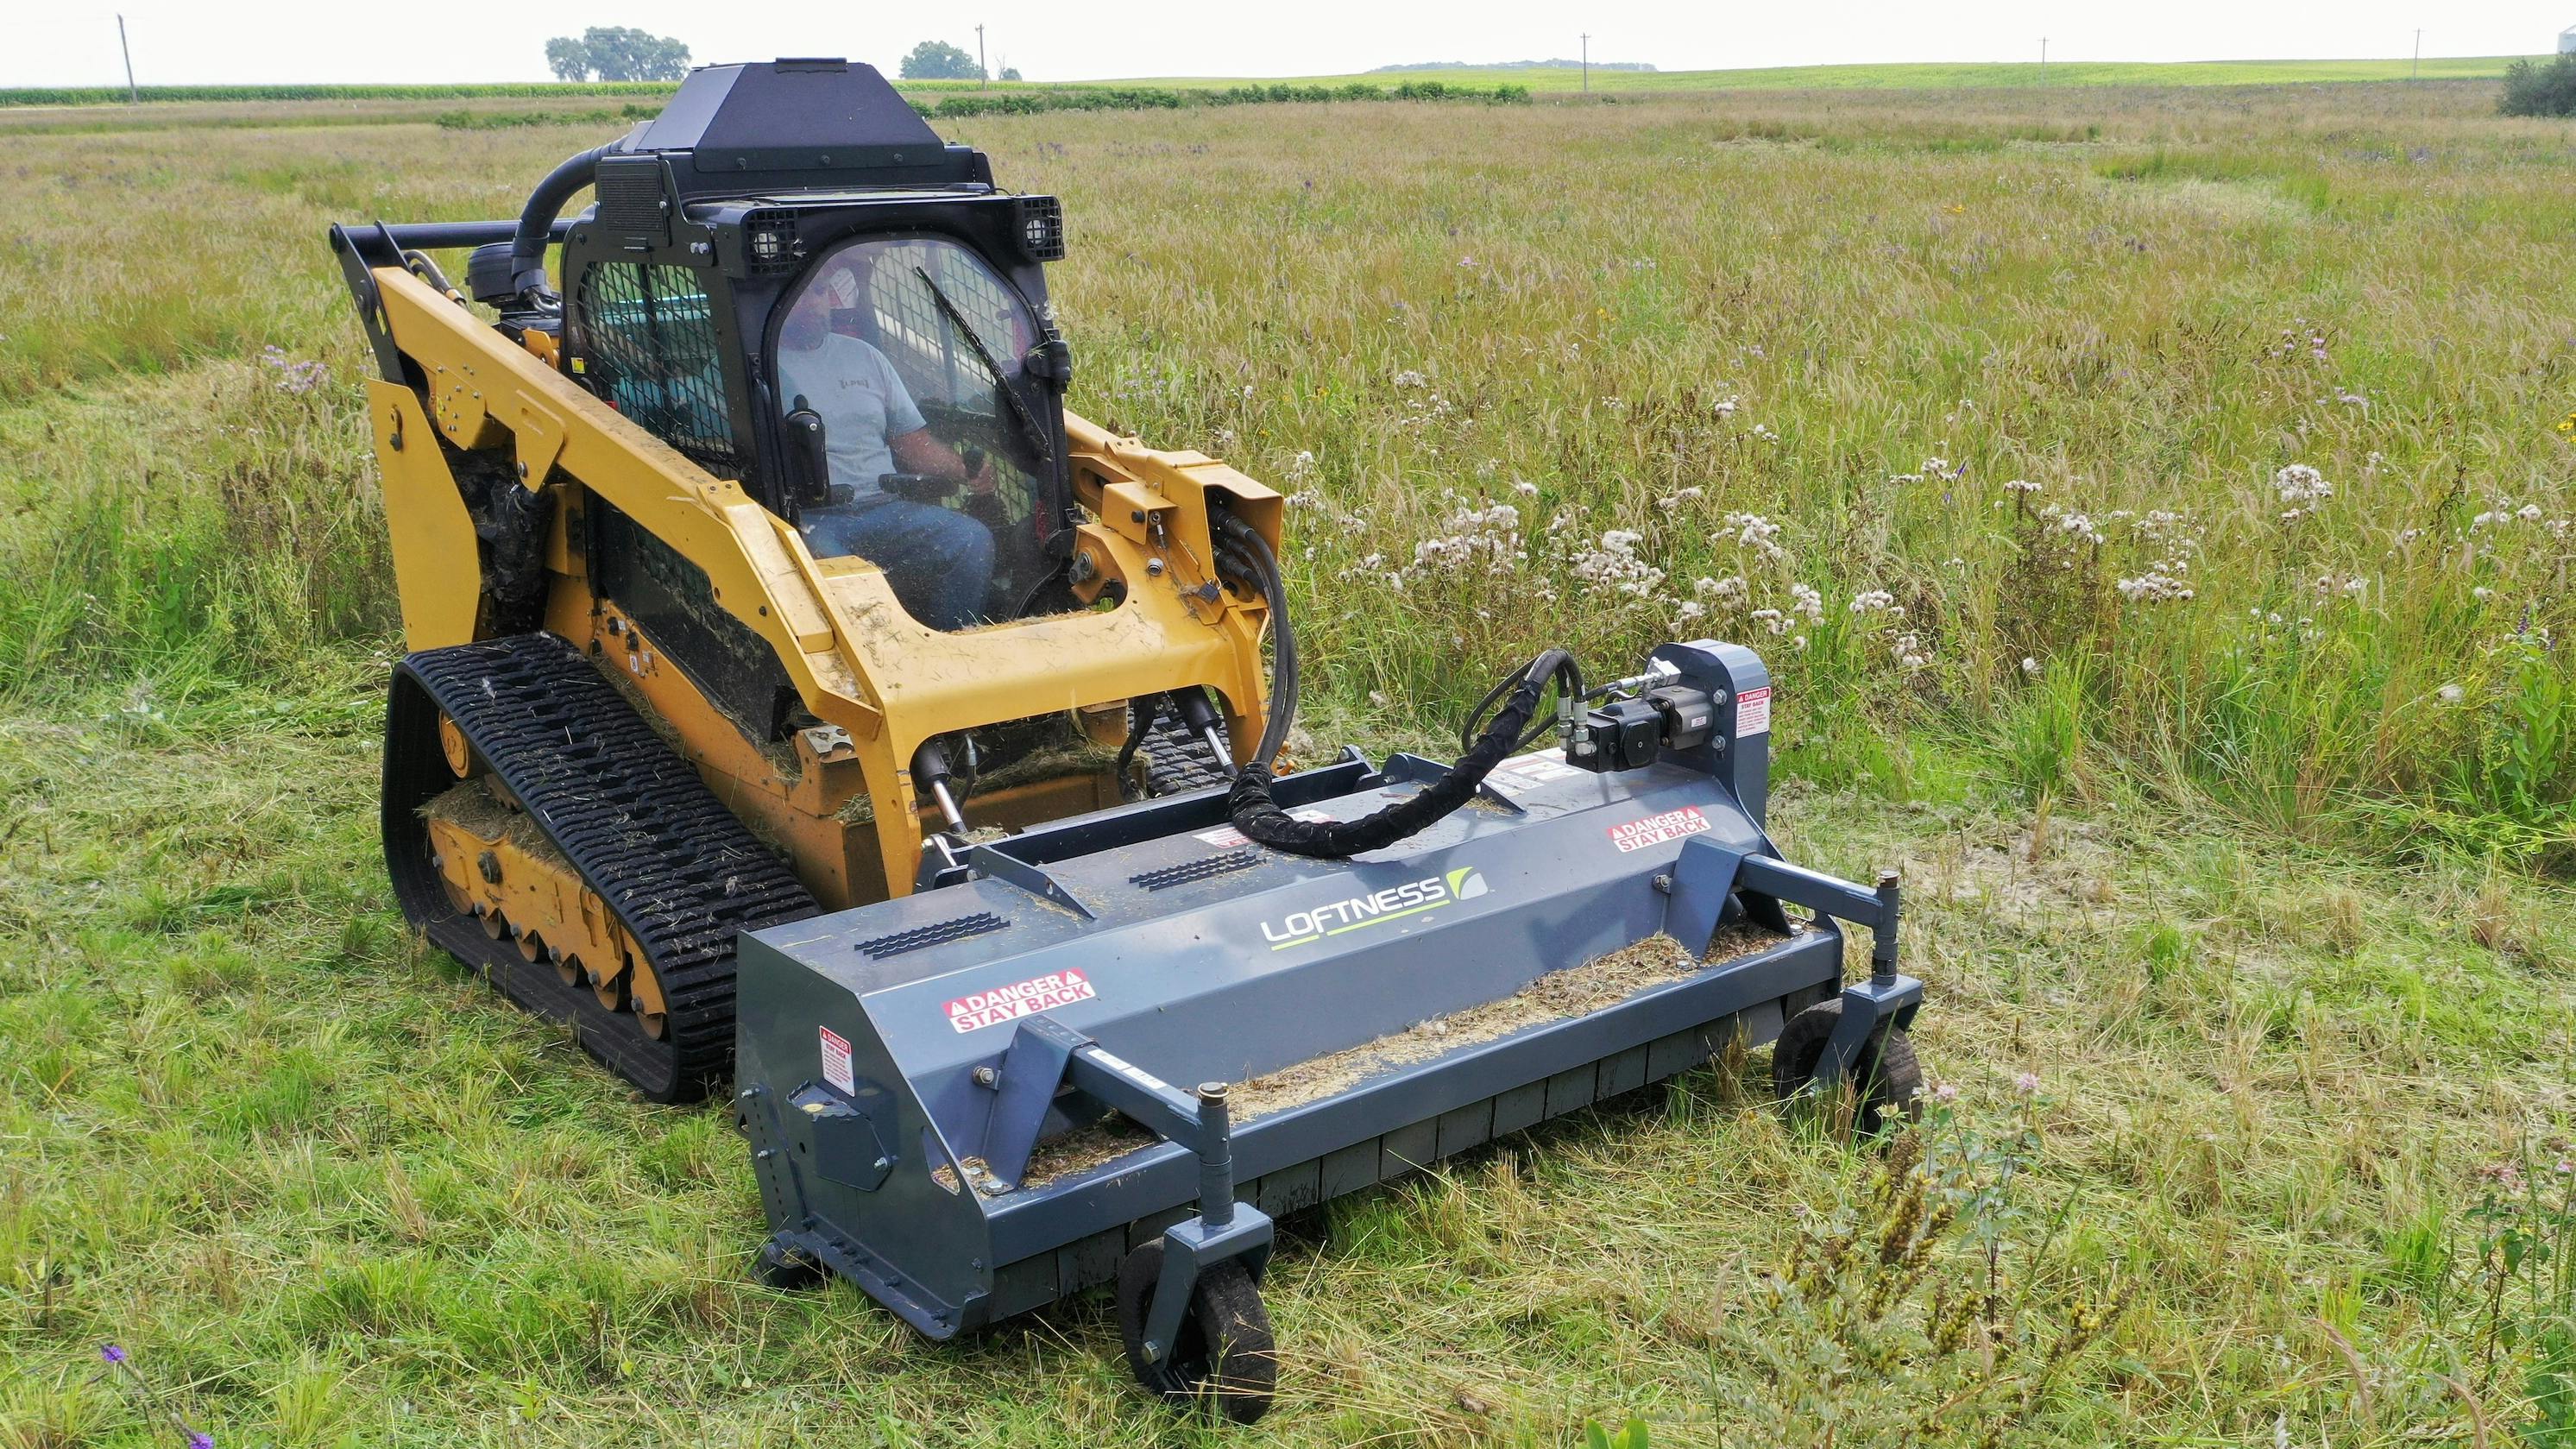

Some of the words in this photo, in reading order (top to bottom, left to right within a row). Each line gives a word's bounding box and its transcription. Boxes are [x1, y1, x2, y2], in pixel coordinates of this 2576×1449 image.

[1744, 690, 1767, 701] DANGER
[1619, 831, 1660, 850] STAY
[1662, 819, 1707, 838] BACK
[1621, 810, 1688, 835] DANGER
[1260, 876, 1446, 942] LOFTNESS
[956, 1003, 1018, 1030] STAY
[1024, 984, 1092, 1012] BACK
[966, 974, 1064, 1011] DANGER
[827, 1033, 848, 1052] DANGER
